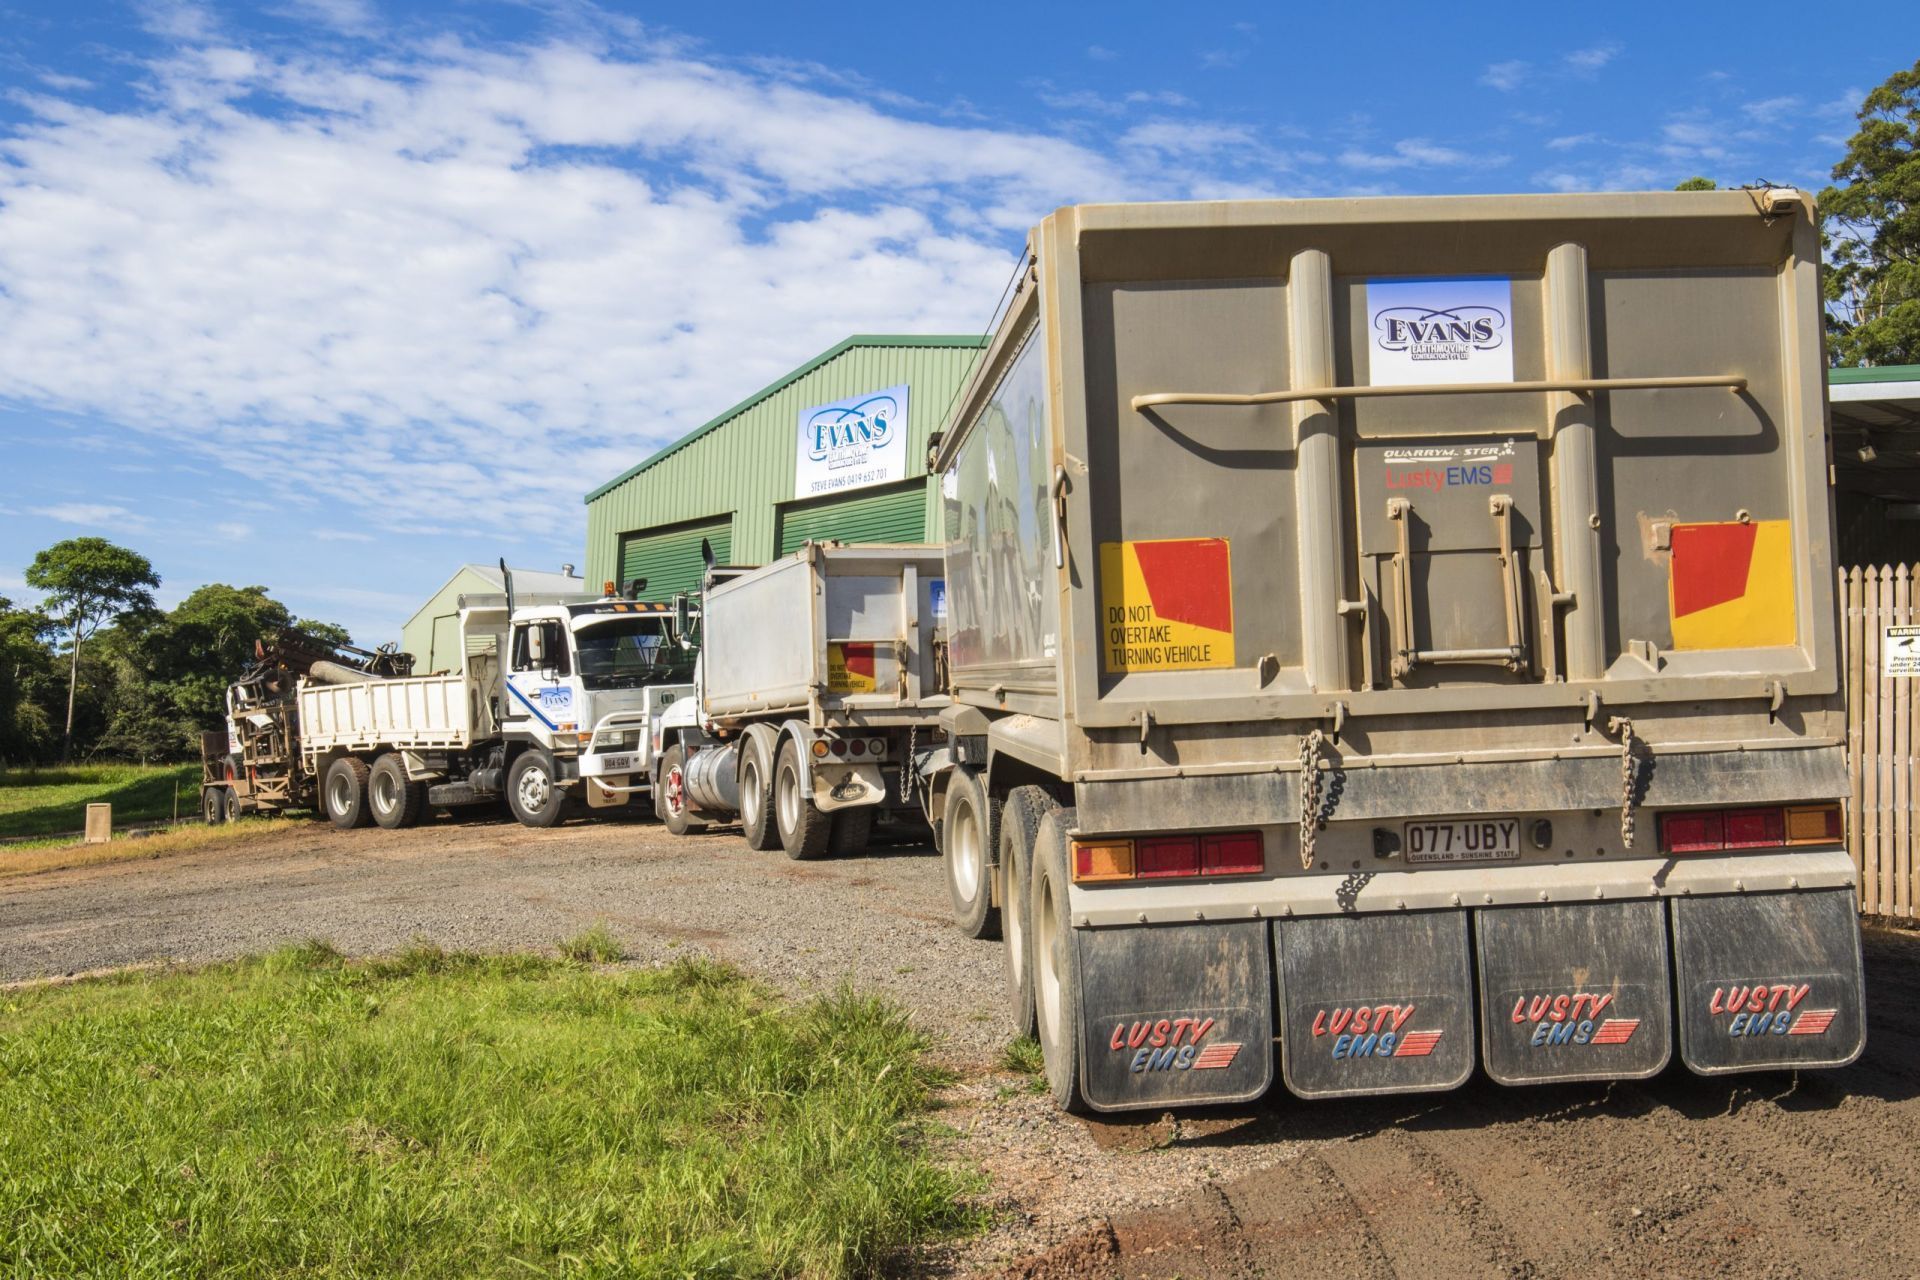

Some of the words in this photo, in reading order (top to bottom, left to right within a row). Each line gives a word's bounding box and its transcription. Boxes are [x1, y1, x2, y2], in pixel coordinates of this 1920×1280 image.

[1386, 317, 1494, 344] EVANS
[1411, 344, 1470, 354] EARTHMOVING
[813, 409, 888, 454] EVANS
[811, 480, 827, 493] STEVE
[828, 476, 846, 489] EVANS
[1109, 606, 1126, 624] DO
[1128, 605, 1152, 622] NOT
[1110, 625, 1172, 645] OVERTAKE
[1890, 628, 1920, 637] WARNI
[1112, 647, 1162, 666] TURNING
[1164, 644, 1212, 663] VEHICLE
[1411, 853, 1454, 861] QUEENSLAND
[1461, 851, 1493, 859] SUNSHINE
[1496, 850, 1514, 858] STATE
[1512, 993, 1613, 1024] LUSTY
[1710, 984, 1810, 1015] LUSTY
[1110, 1017, 1214, 1050] LUSTY
[1312, 1004, 1415, 1037] LUSTY
[1531, 1020, 1594, 1047] EMS
[1729, 1011, 1792, 1038] EMS
[1130, 1045, 1195, 1073] EMS
[1332, 1032, 1396, 1060] EMS
